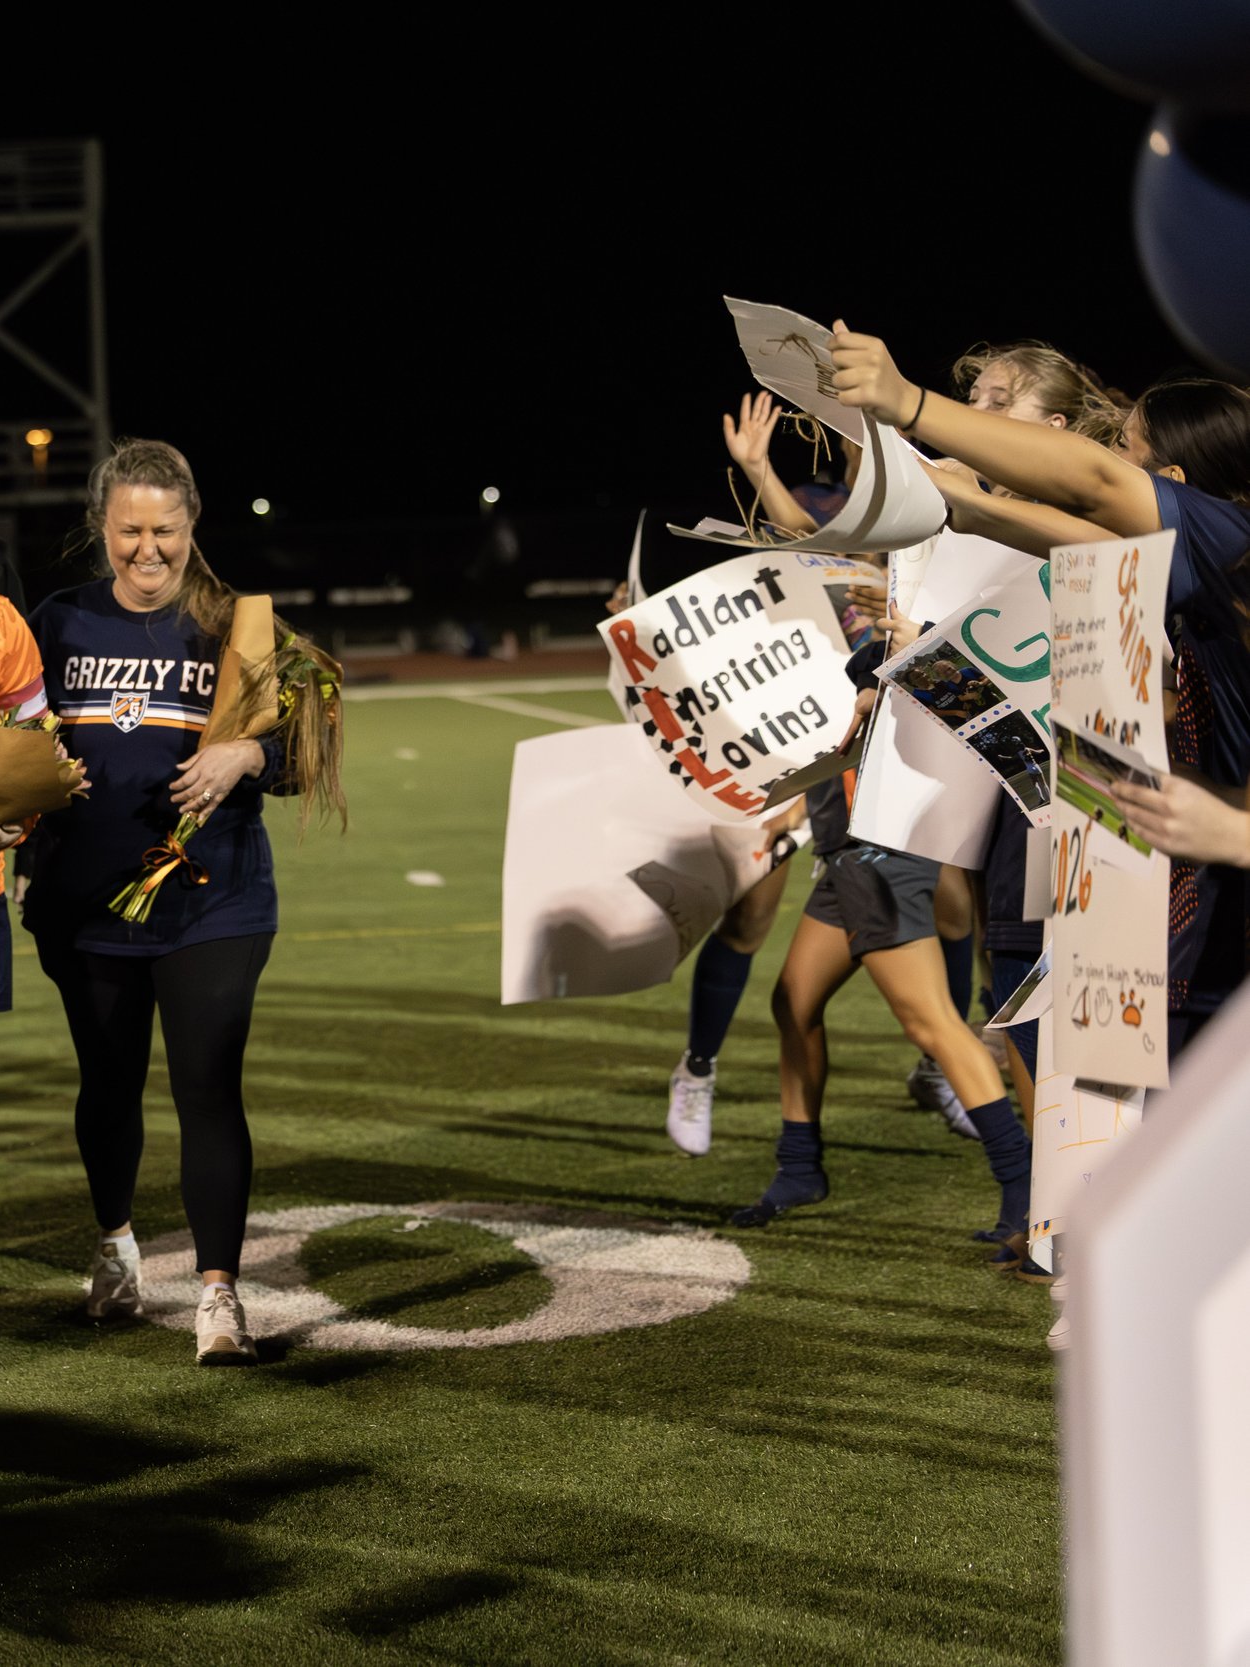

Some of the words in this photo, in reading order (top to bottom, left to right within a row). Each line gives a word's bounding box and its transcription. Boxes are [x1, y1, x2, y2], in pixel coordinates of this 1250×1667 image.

[608, 566, 786, 684] Radiant
[64, 656, 176, 691] GRIZZLY
[179, 660, 215, 696] FC
[642, 628, 811, 743] Inspiring
[675, 694, 829, 790] Loving
[1051, 818, 1092, 916] 2026
